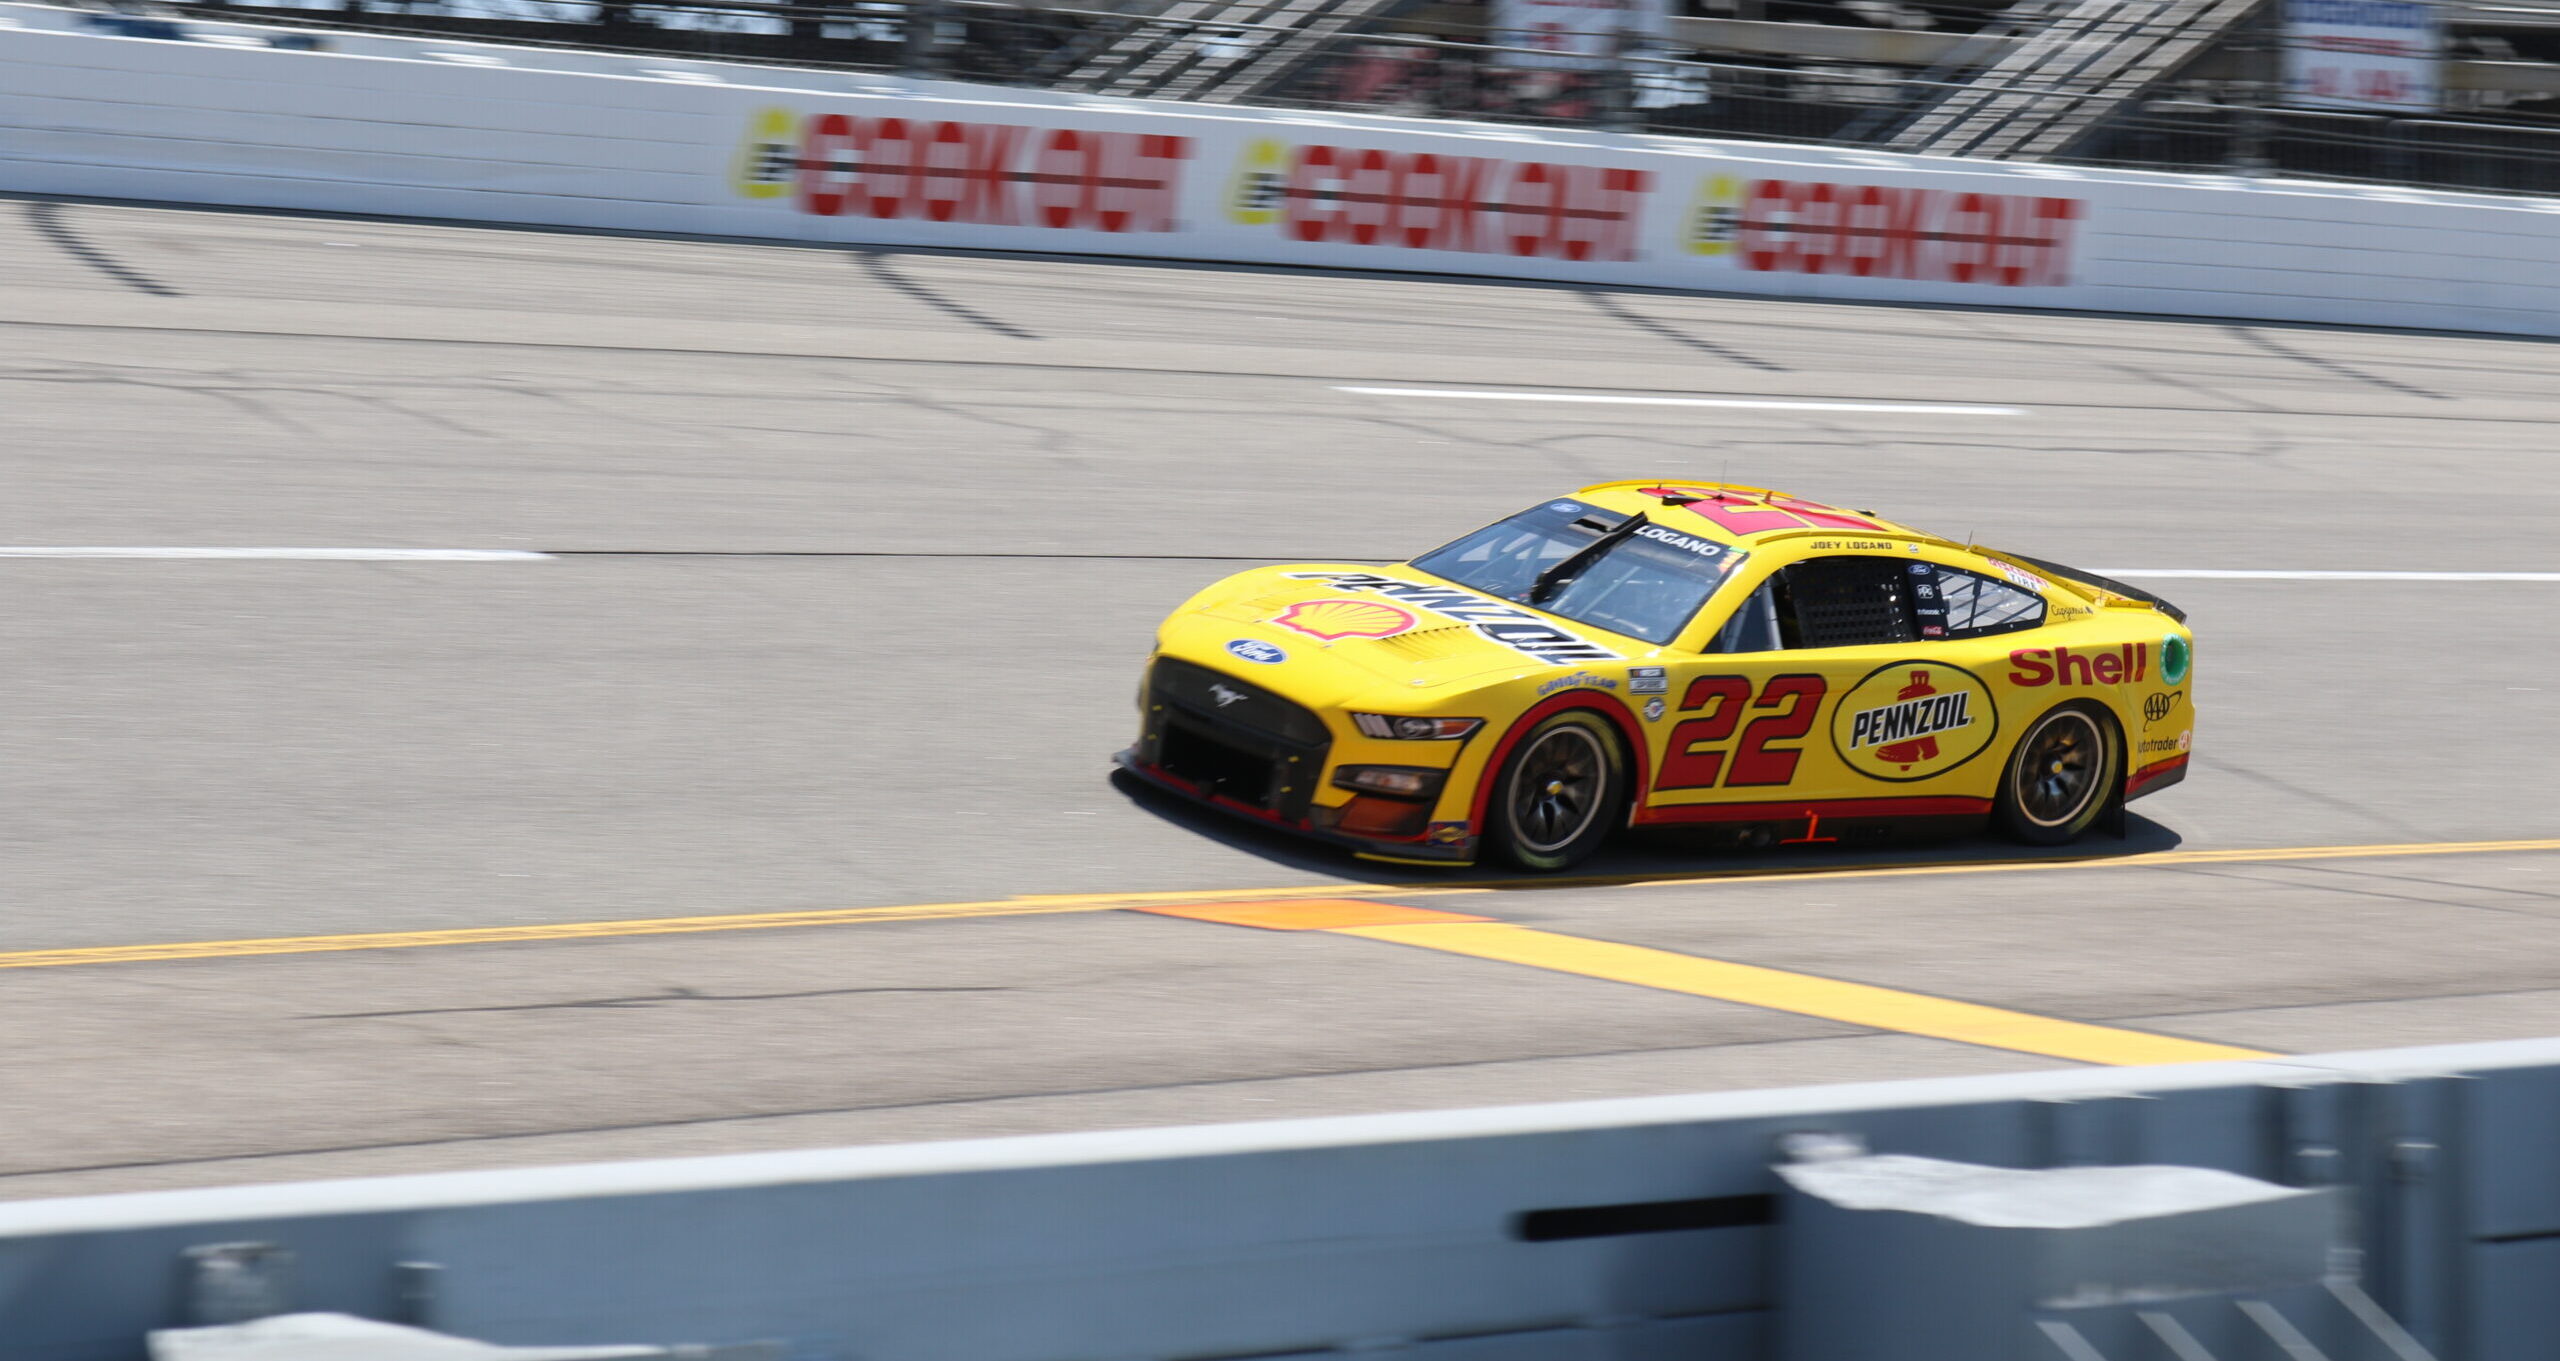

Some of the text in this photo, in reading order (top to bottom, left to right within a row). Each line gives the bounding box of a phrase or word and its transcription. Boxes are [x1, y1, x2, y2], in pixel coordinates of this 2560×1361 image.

[798, 113, 1197, 233] COOK OUT
[1284, 144, 1657, 262] COOK OUT
[1738, 178, 2086, 287] COOK OUT
[1632, 525, 1721, 557] LOGANO
[1810, 541, 1893, 550] JOEY LOGANO
[1280, 572, 1630, 666] PENNZOIL
[2008, 642, 2147, 688] Shell
[1653, 673, 1828, 792] 22
[1850, 691, 1970, 750] PENNZOIL
[2145, 694, 2169, 720] AAA
[2138, 737, 2177, 753] utotrader
